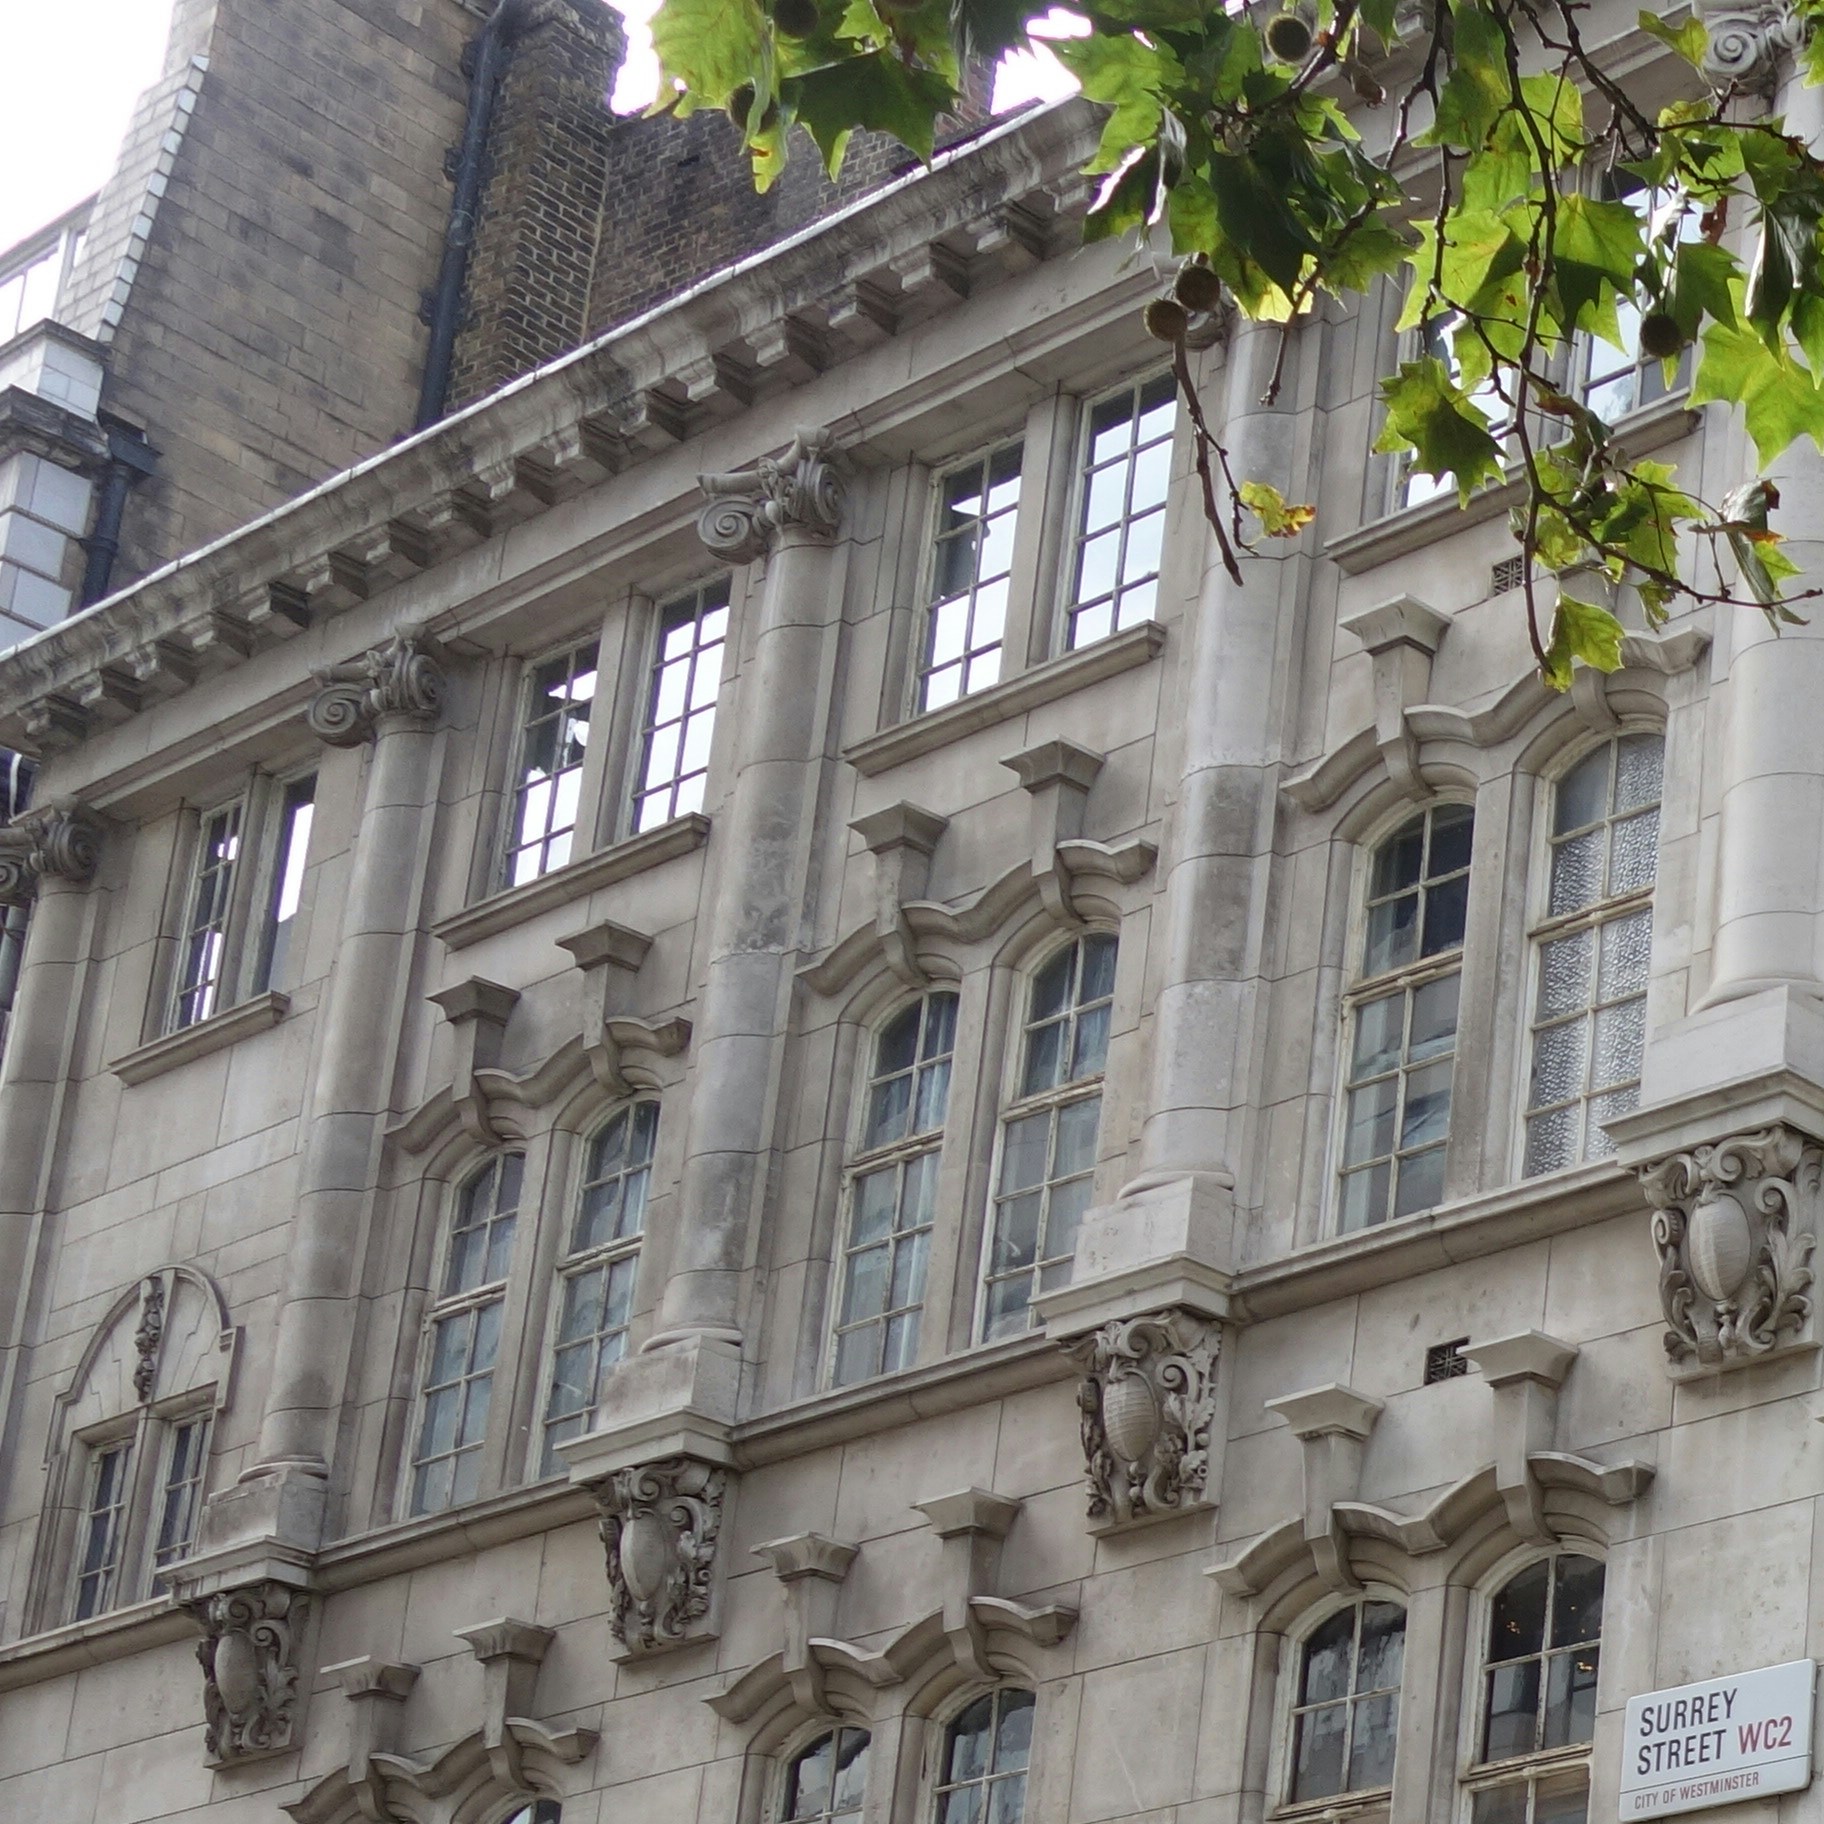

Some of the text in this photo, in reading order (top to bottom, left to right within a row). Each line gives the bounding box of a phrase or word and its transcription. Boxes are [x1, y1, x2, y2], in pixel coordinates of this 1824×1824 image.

[1640, 1688, 1739, 1737] SURREY
[1637, 1716, 1793, 1775] STREET WC2
[1634, 1771, 1759, 1810] CITY OF WESTMINSTER
